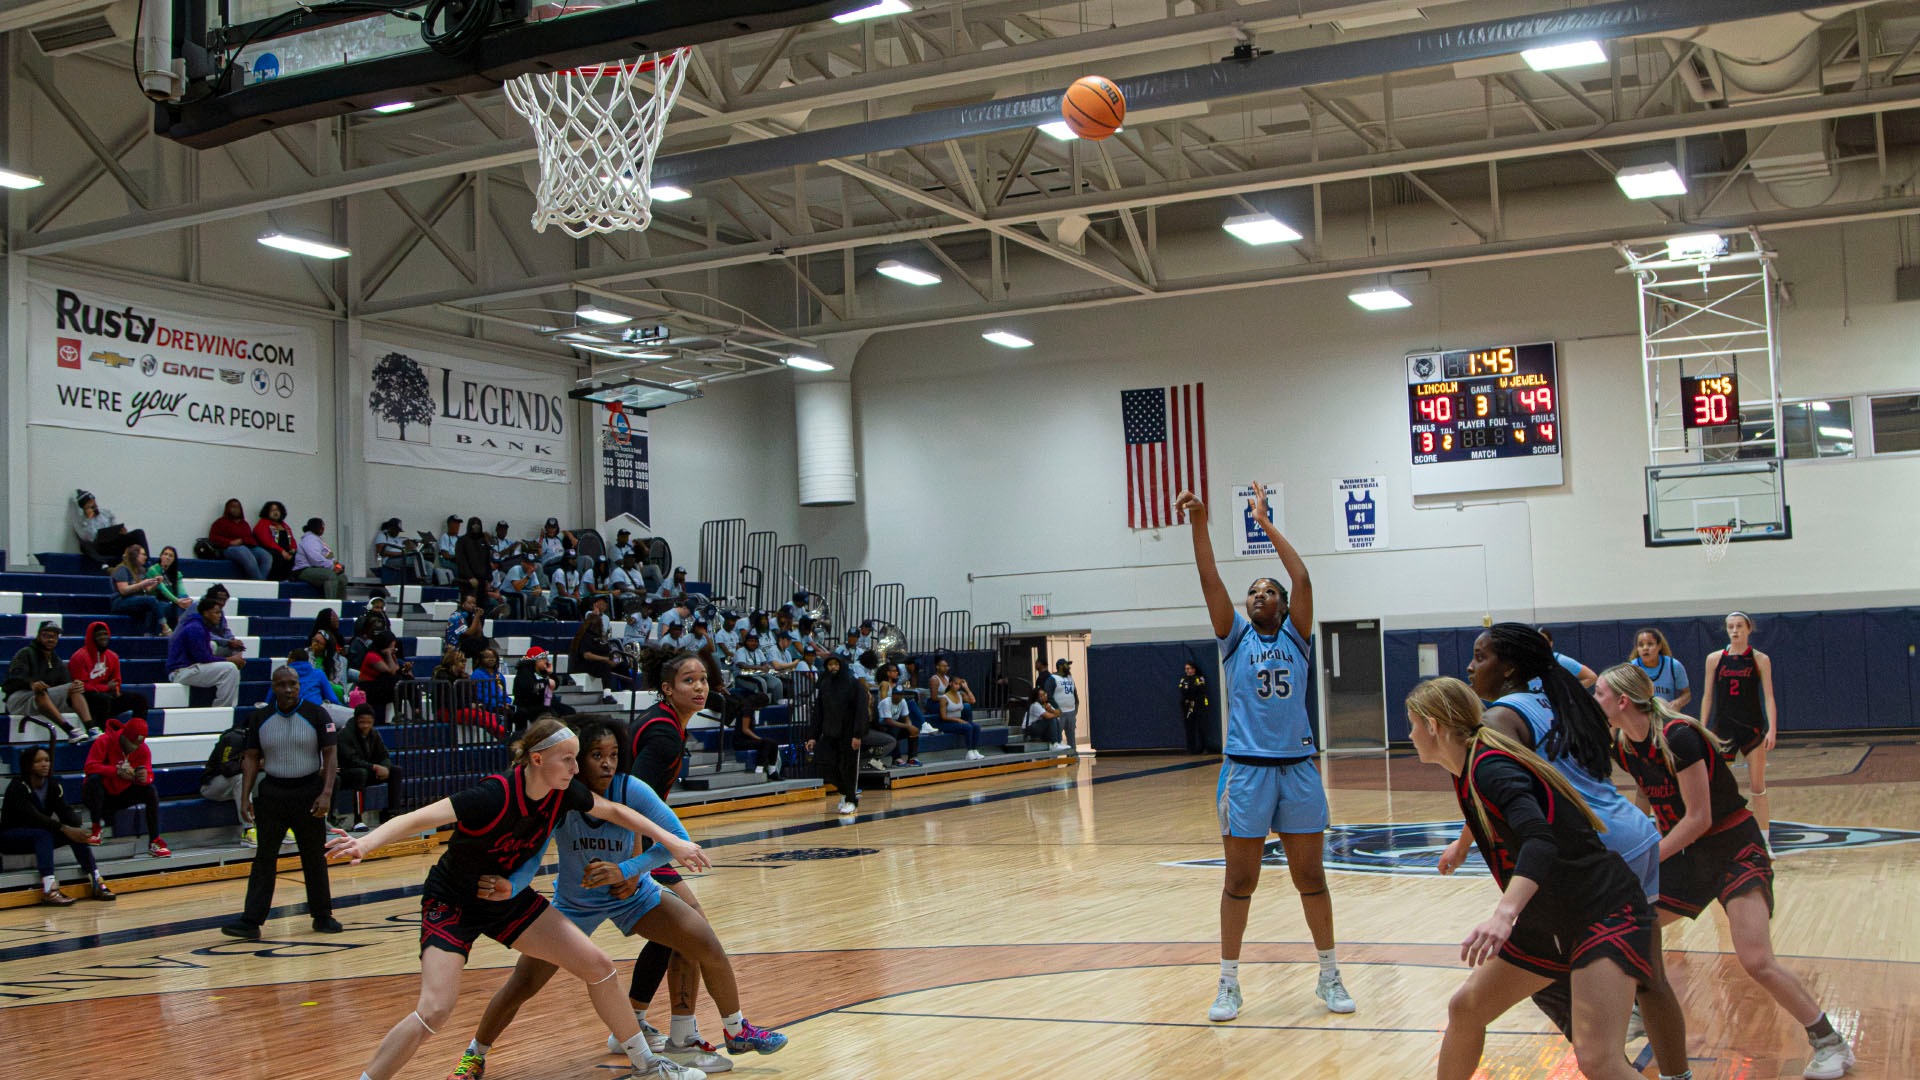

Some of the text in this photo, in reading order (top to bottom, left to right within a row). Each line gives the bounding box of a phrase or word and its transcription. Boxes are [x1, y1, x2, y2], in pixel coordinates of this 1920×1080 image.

[1468, 348, 1514, 375] 1:45
[162, 362, 214, 380] GMC
[1417, 382, 1458, 395] LINCOLN
[1510, 374, 1547, 386] JEWELL
[1470, 385, 1492, 394] GAME
[1701, 376, 1732, 395] 1:45
[57, 384, 295, 433] WE'RE your CAR PEOPLE
[440, 368, 564, 435] LEGENDS
[1420, 388, 1552, 421] 40 3 49
[1694, 394, 1728, 424] 30
[1458, 418, 1508, 429] PLAYER FOUL
[1531, 414, 1555, 422] FOULS
[1412, 424, 1436, 433] FOULS
[456, 434, 552, 455] BANK
[1422, 424, 1552, 452] 3 2 4 4
[1471, 450, 1497, 459] MATCH
[1532, 445, 1557, 454] SCORE
[617, 459, 632, 468] 2004
[1414, 454, 1438, 463] SCORE
[617, 469, 633, 478] 2007
[618, 479, 633, 488] 2018
[1355, 512, 1365, 522] 41
[1250, 650, 1294, 665] LINCOLN
[1257, 669, 1292, 699] 35
[1730, 679, 1739, 695] 2
[573, 838, 622, 852] LNCOLN
